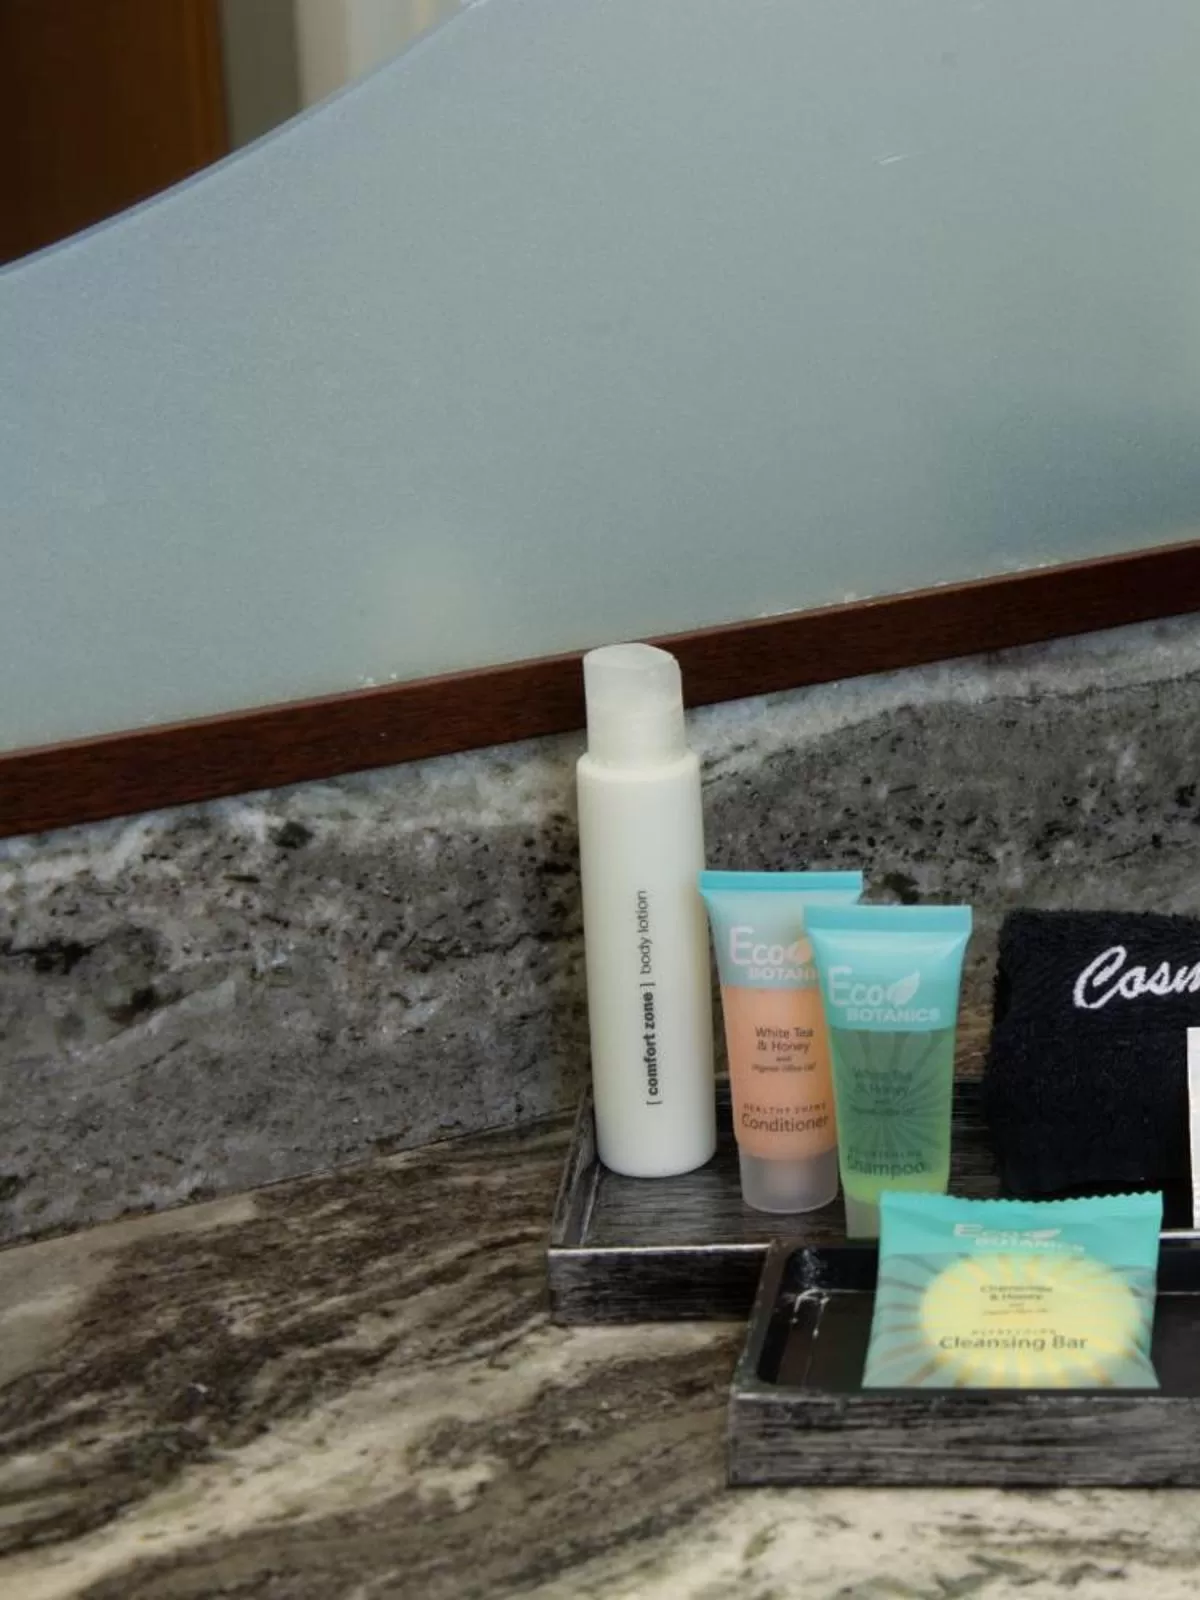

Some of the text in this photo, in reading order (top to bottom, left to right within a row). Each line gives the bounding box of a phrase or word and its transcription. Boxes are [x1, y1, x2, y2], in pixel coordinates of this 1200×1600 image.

[635, 890, 649, 933] lotion
[637, 936, 653, 975] body
[729, 926, 785, 966] Eco
[828, 965, 884, 1008] Eco
[642, 991, 656, 1030] zone
[846, 1007, 940, 1022] BOTANICS
[754, 1026, 790, 1039] White
[756, 1039, 811, 1055] & Honey
[642, 1033, 659, 1096] comfort
[741, 1112, 829, 1134] Conditioner
[939, 1334, 1088, 1352] Cleansing Bar
